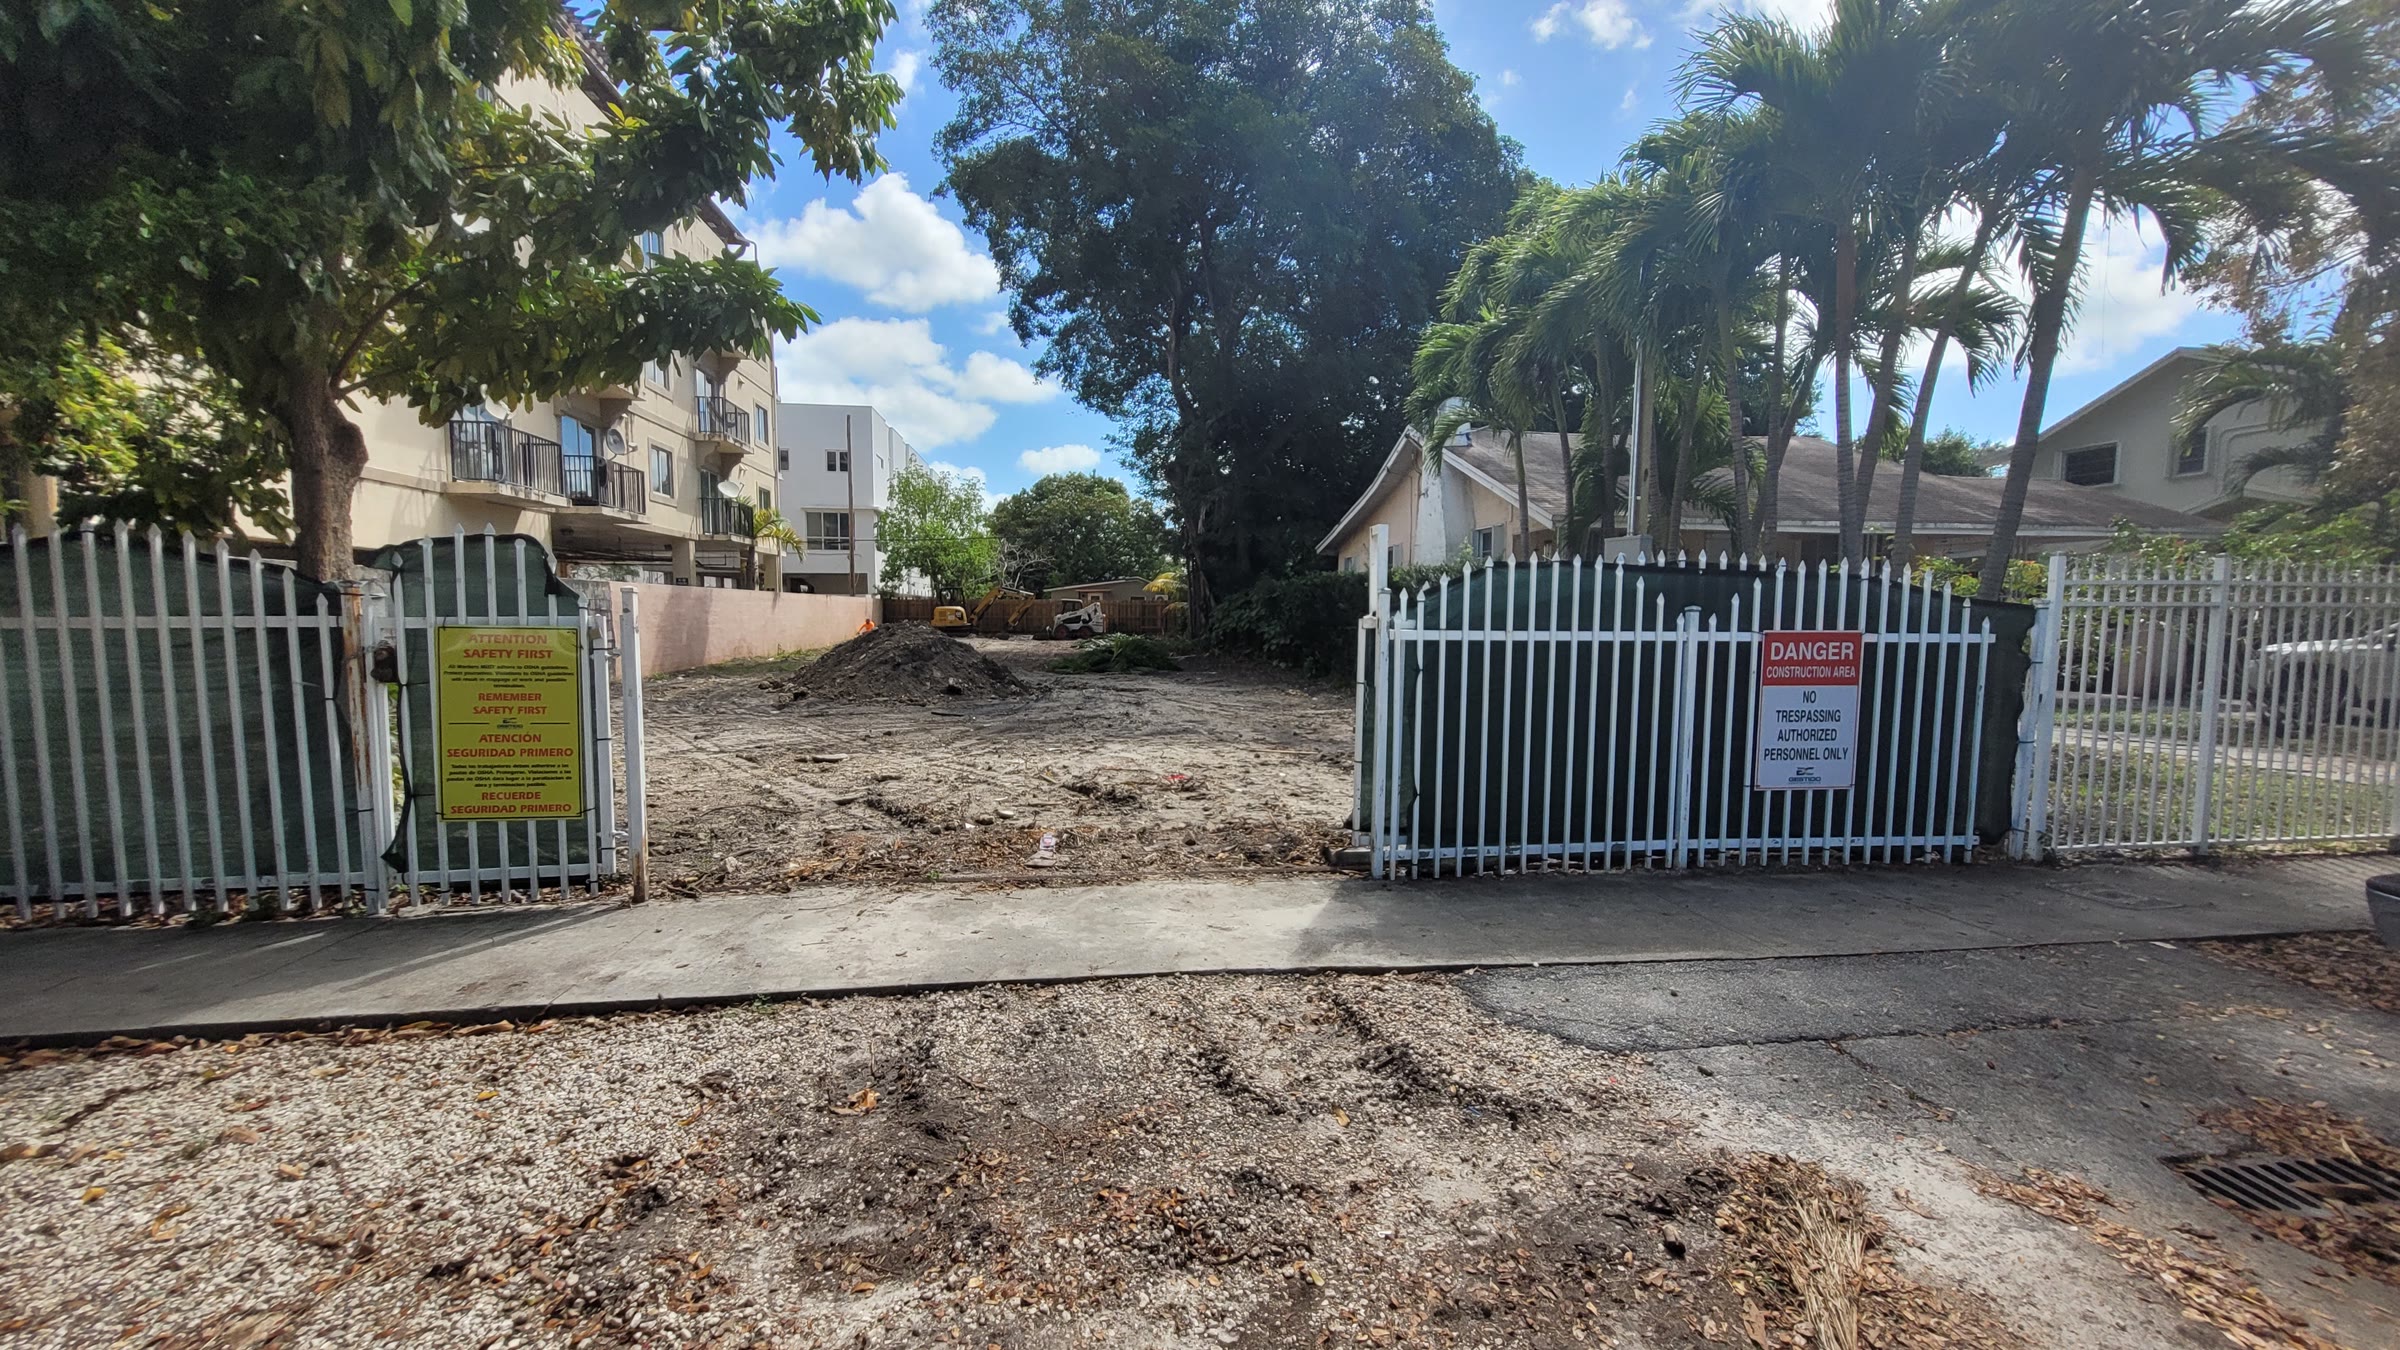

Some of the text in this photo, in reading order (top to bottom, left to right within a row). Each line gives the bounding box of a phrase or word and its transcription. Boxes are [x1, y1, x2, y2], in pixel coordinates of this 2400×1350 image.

[468, 634, 547, 645] ATTENTION
[463, 649, 553, 659] SAFETY FIRST
[1770, 641, 1854, 661] DANGER
[1766, 666, 1856, 679] CONSTRUCTION AREA
[478, 692, 542, 701] REMEMBER
[1802, 690, 1816, 704] NO
[472, 706, 547, 714] SAFETY FIRST
[1776, 709, 1841, 723] TRESPASSING
[479, 732, 542, 743] ATENCIÓN
[1777, 728, 1838, 742] AUTHORIZED
[447, 747, 574, 758] SEGURIDAD PRIMERO
[1763, 747, 1849, 761] PERSONNEL ONLY
[481, 791, 541, 800] RECUERDE
[451, 804, 571, 814] SEGURIDAD PRIMERO
